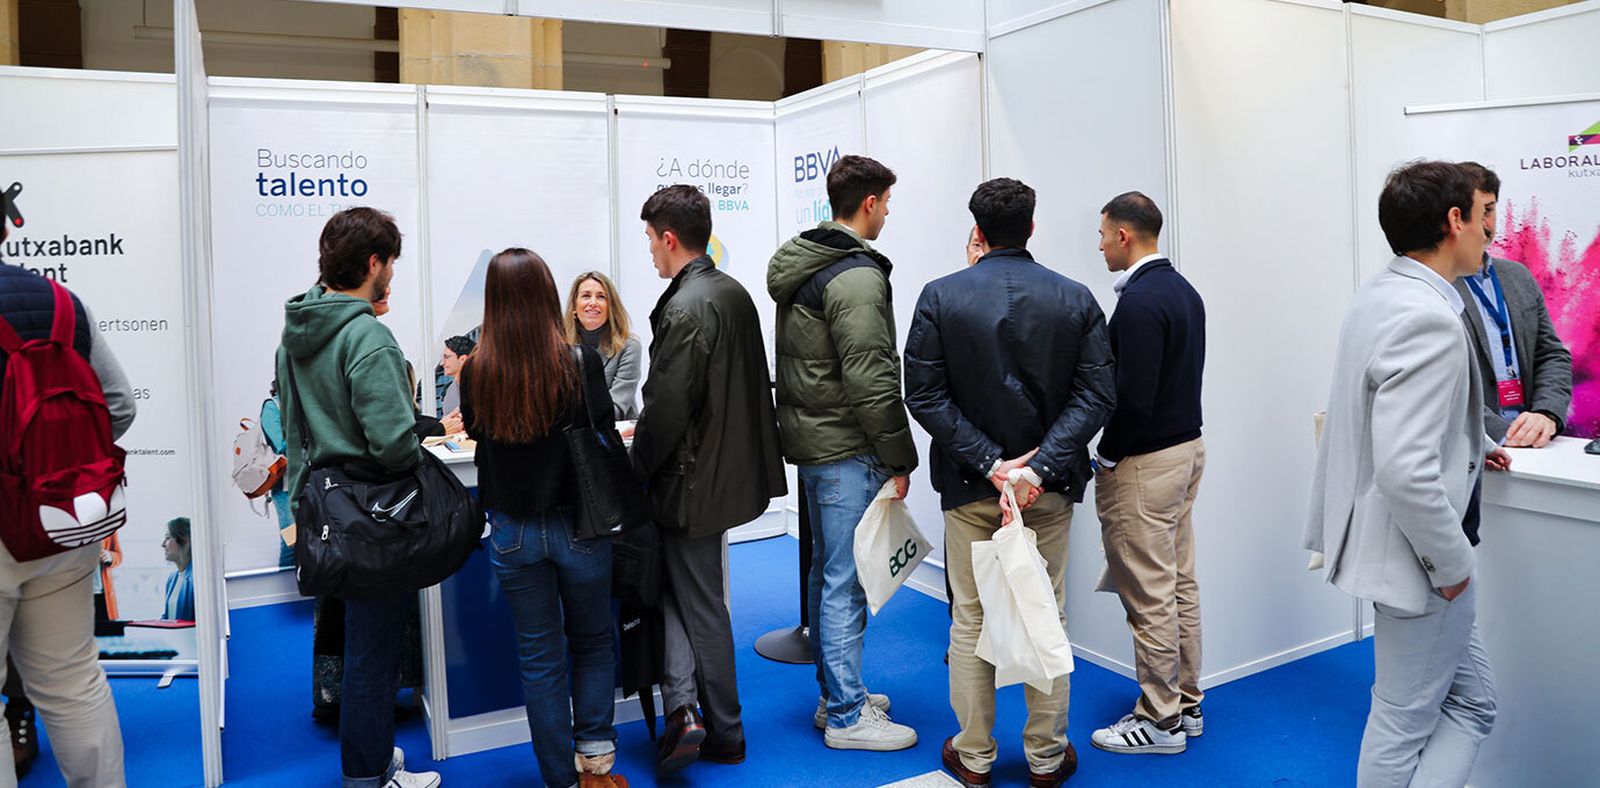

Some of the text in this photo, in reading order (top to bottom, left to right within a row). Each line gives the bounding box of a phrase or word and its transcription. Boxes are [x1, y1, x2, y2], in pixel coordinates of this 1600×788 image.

[257, 148, 368, 169] Buscando
[656, 157, 750, 179] ¿A dónde
[1520, 154, 1600, 170] LABORAL
[256, 172, 368, 197] talento
[708, 182, 749, 198] llegar?
[256, 203, 305, 217] COMO
[308, 203, 328, 217] EL
[718, 199, 750, 211] BBVA
[813, 199, 831, 222] líd
[3, 233, 124, 257] utxabank
[98, 318, 168, 332] ertsonen
[888, 538, 917, 578] BCG
